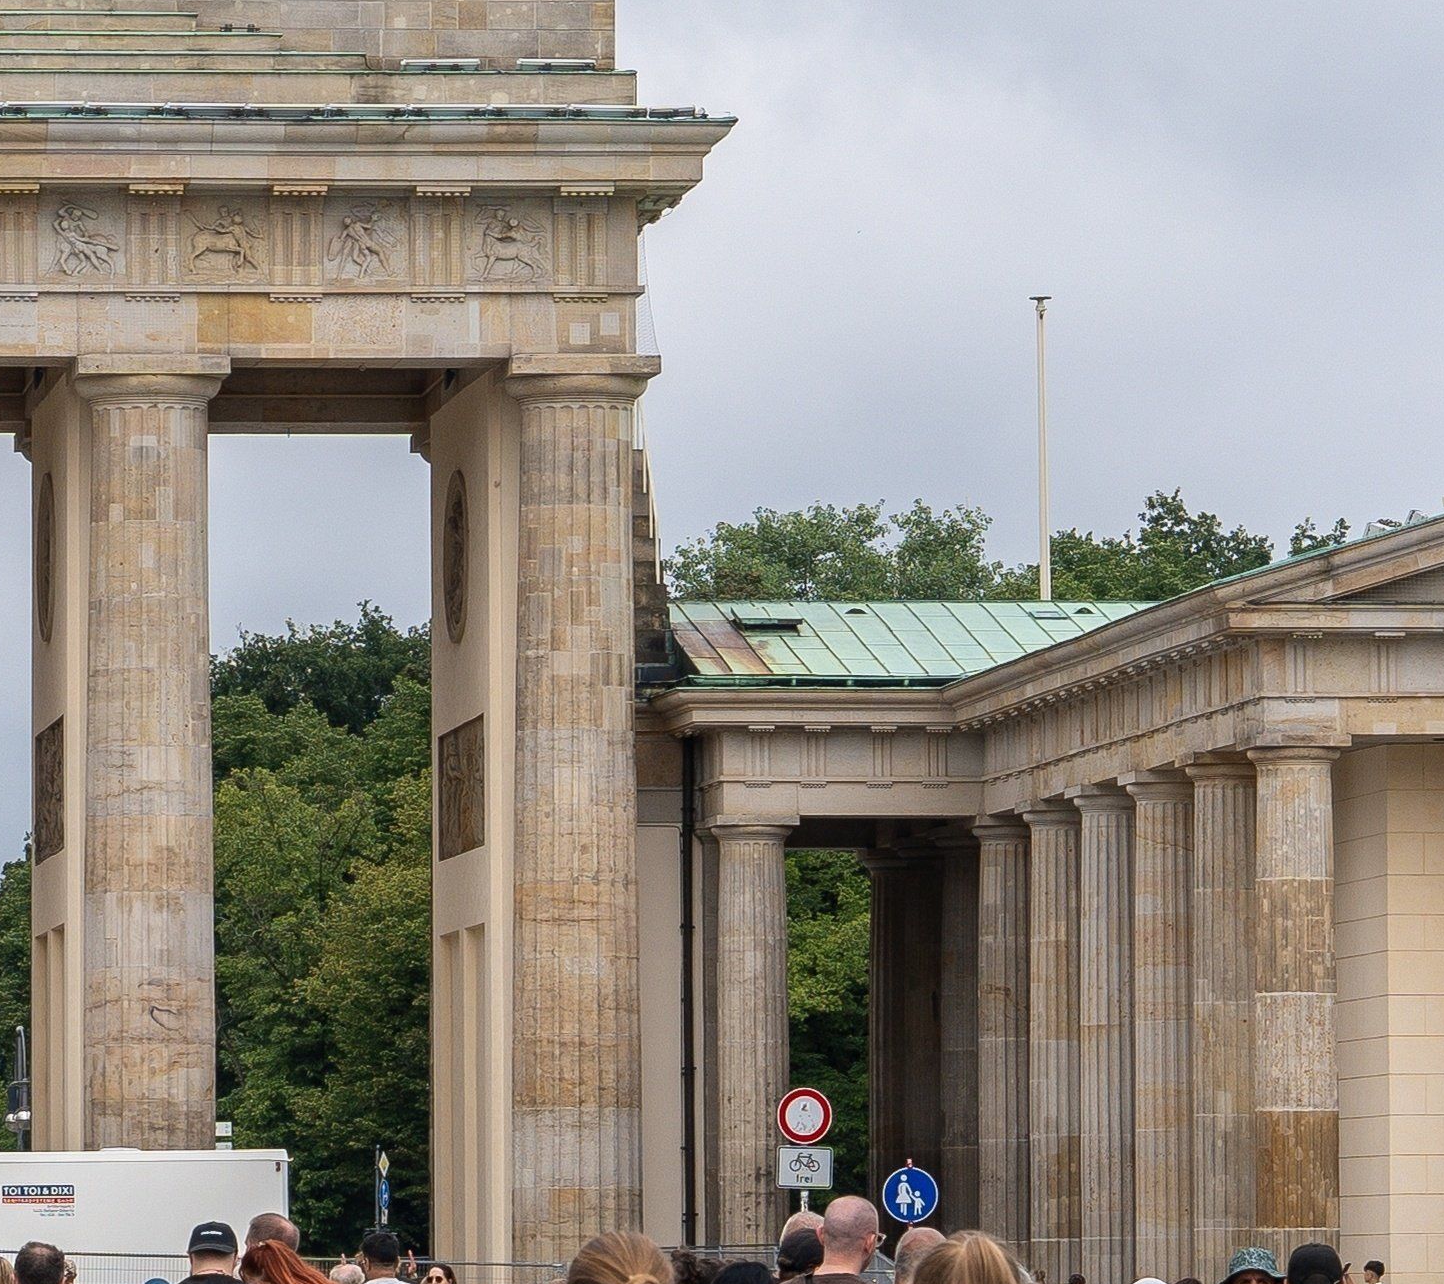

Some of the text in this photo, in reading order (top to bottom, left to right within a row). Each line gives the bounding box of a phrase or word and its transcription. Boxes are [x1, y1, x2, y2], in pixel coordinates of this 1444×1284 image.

[796, 1174, 813, 1183] frei
[3, 1186, 73, 1195] TOI TOI & DIXI
